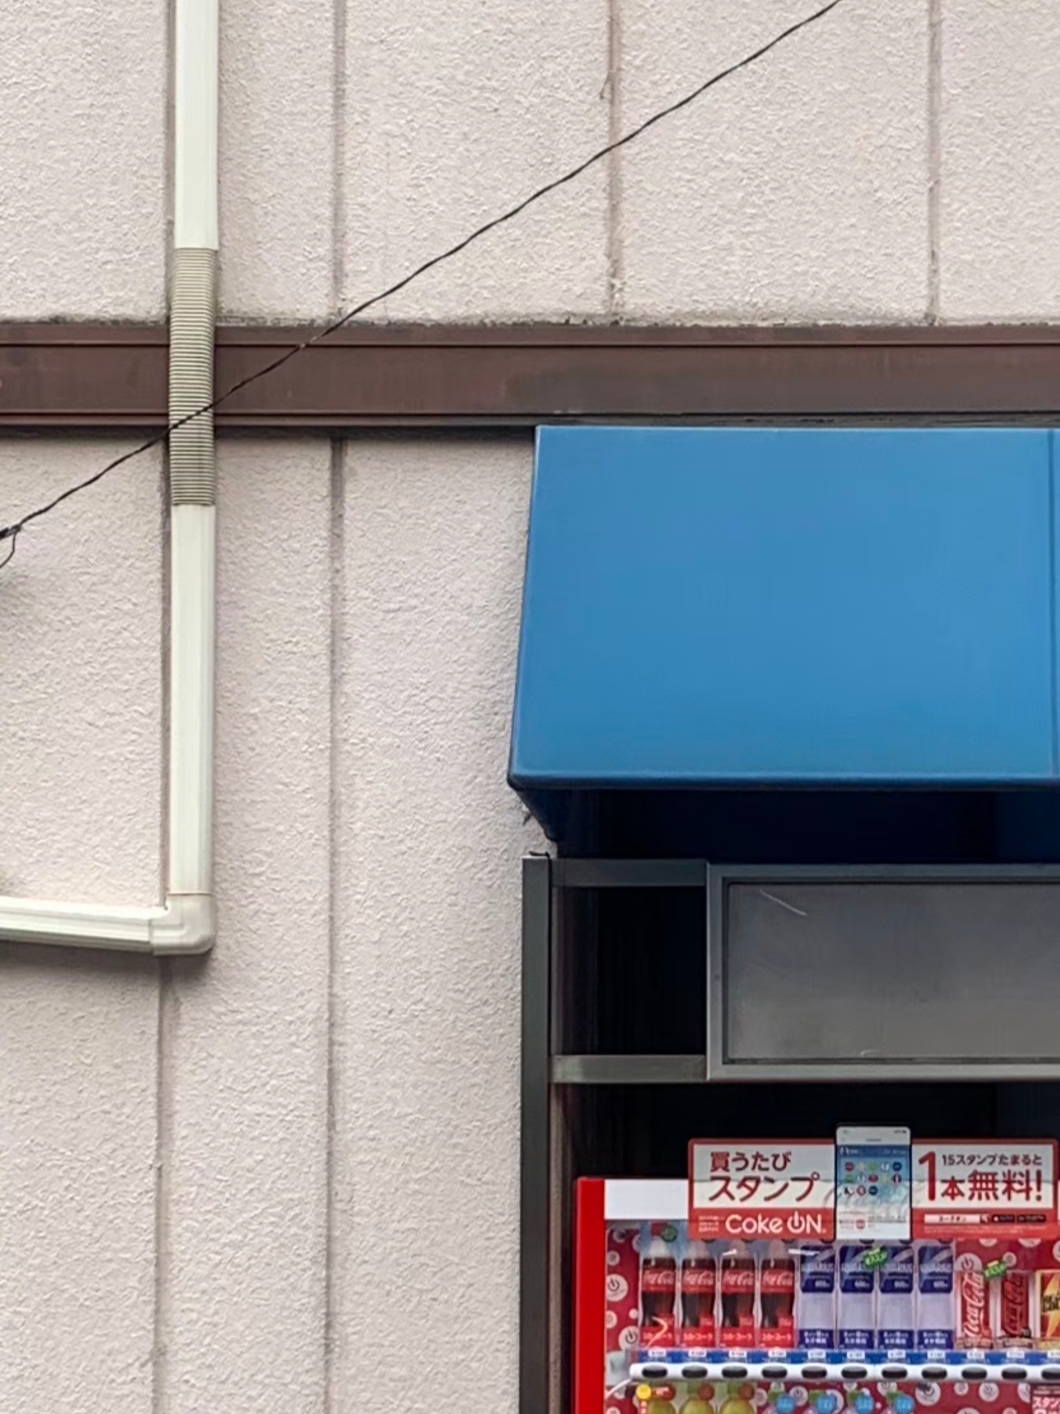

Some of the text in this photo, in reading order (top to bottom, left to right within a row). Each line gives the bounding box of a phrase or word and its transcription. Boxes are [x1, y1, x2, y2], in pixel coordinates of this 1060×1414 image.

[710, 1151, 792, 1173] 買うたび
[709, 1171, 820, 1202] スタンプ
[725, 1213, 783, 1234] Coke
